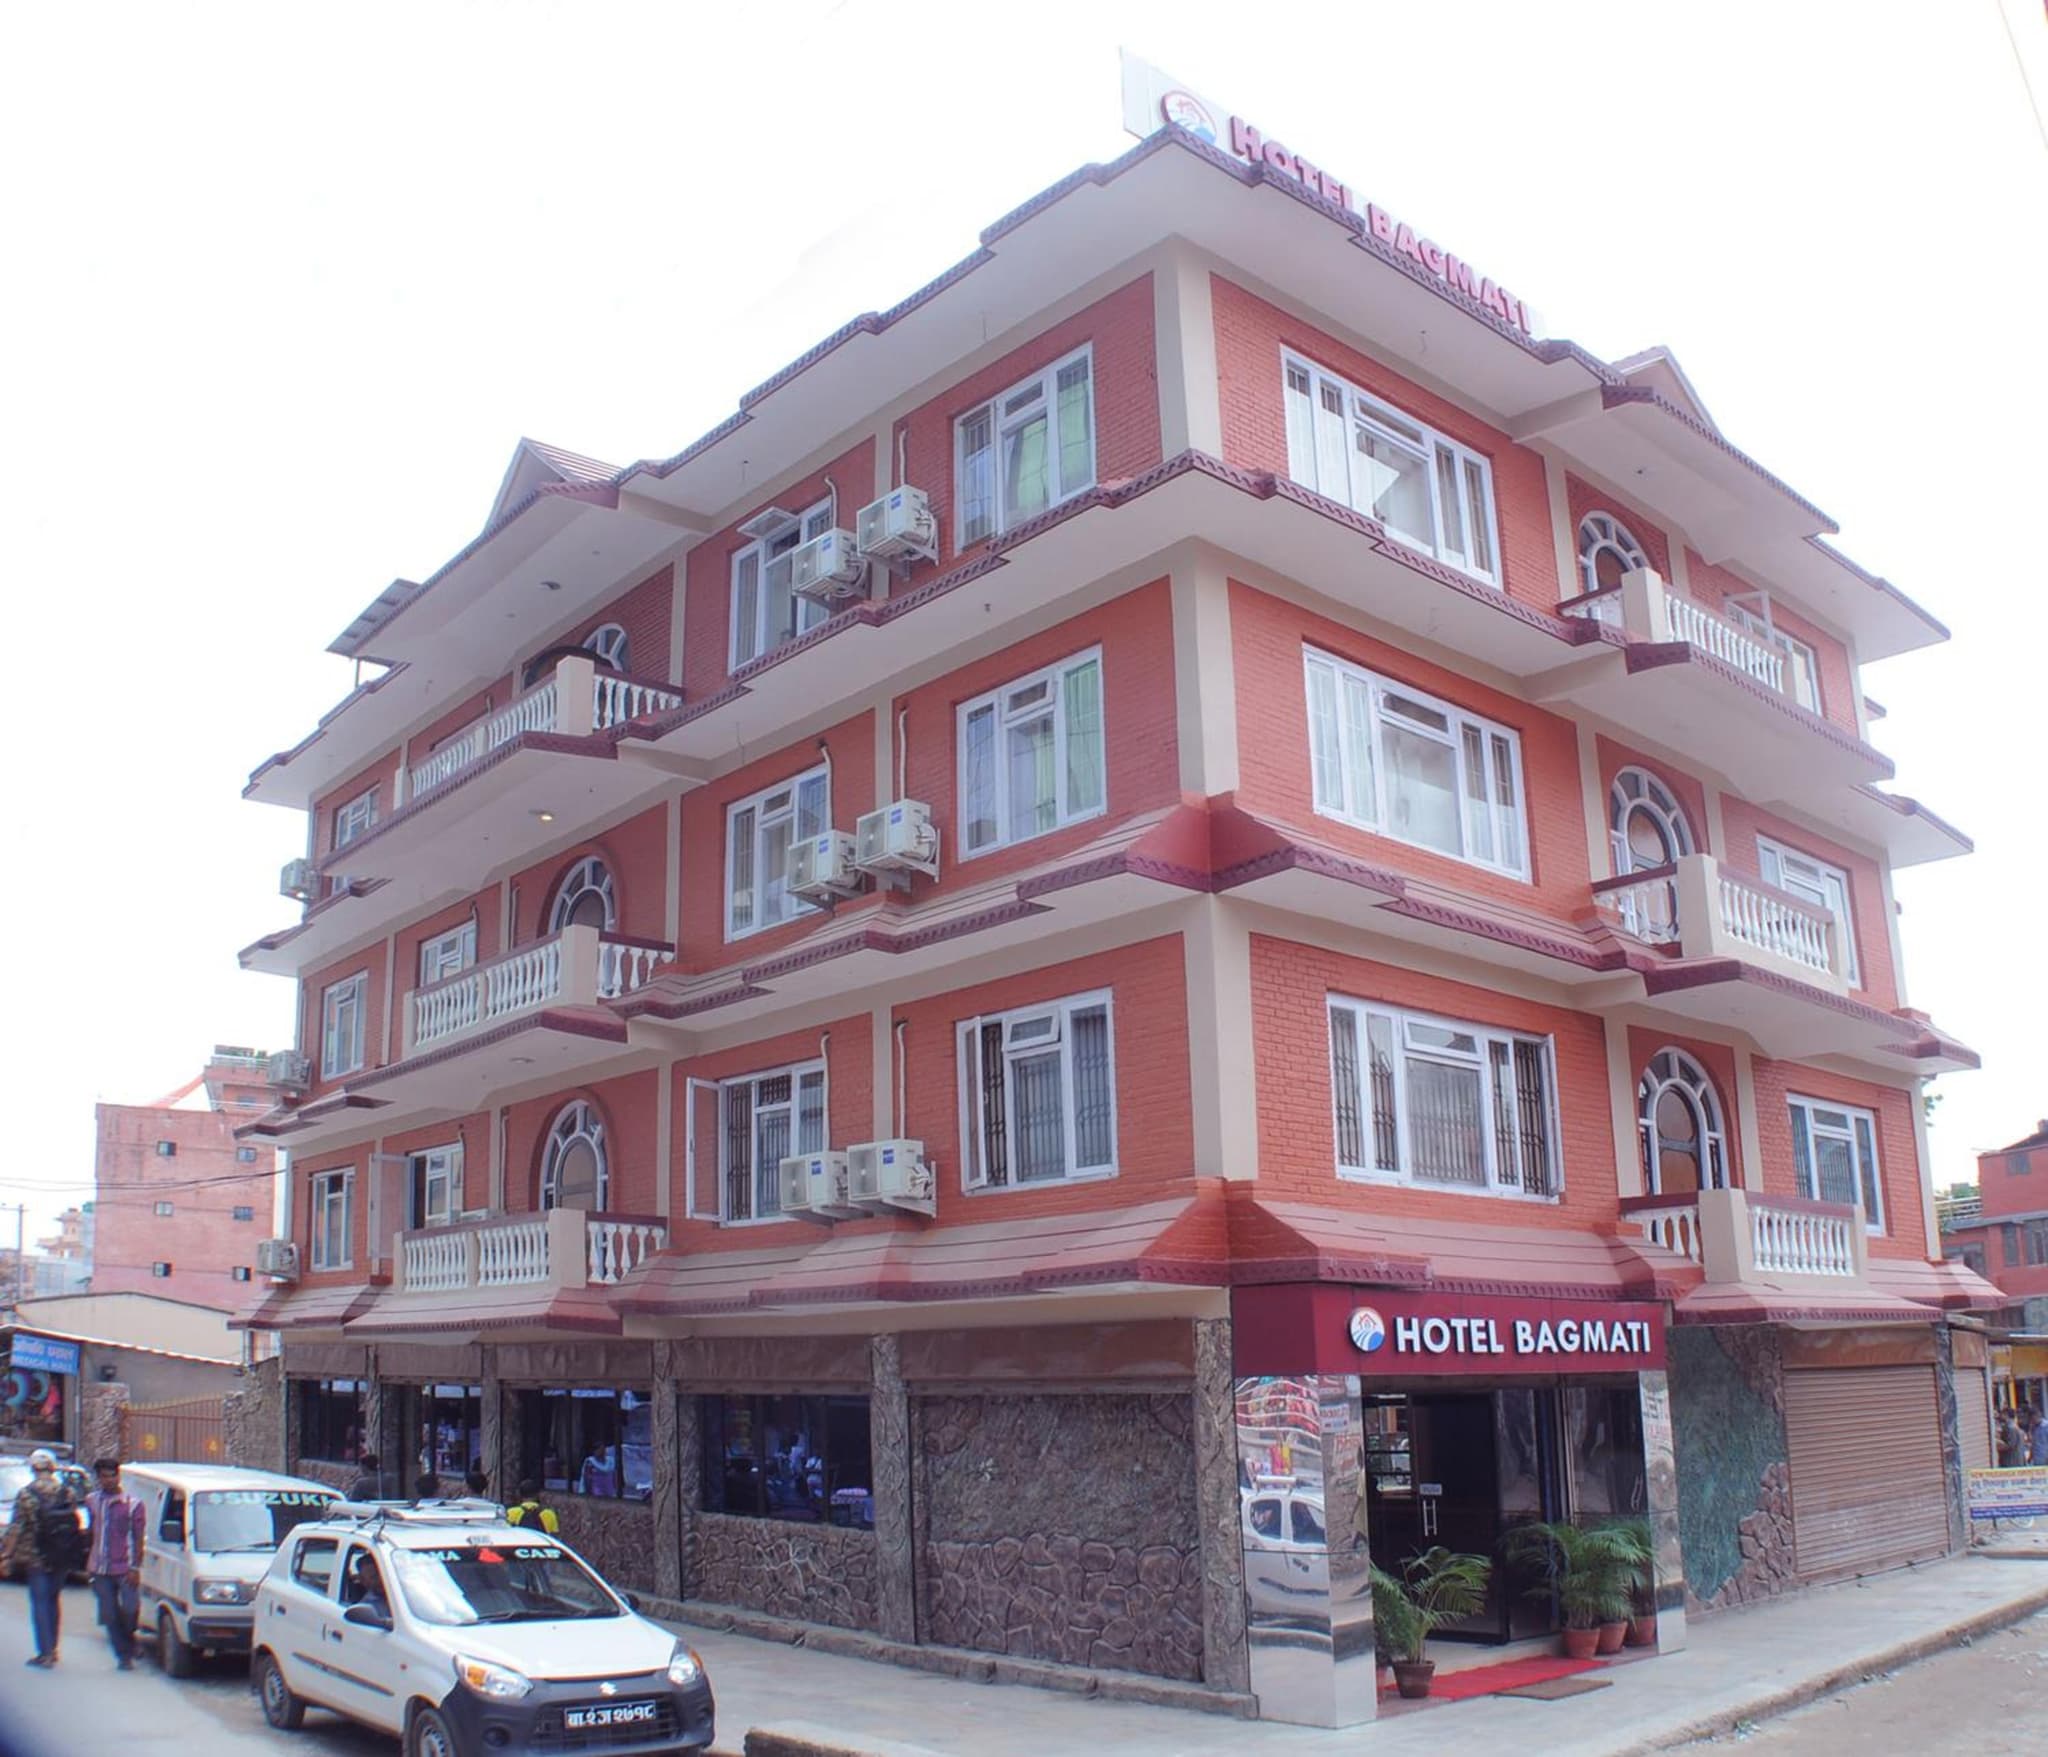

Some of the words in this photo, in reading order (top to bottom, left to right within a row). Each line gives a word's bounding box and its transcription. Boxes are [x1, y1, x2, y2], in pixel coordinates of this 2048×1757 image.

[1367, 202, 1531, 336] BAGMATI
[1394, 1316, 1505, 1354] HOTEL
[1514, 1319, 1651, 1354] BAGMATI
[514, 1548, 561, 1560] CAB
